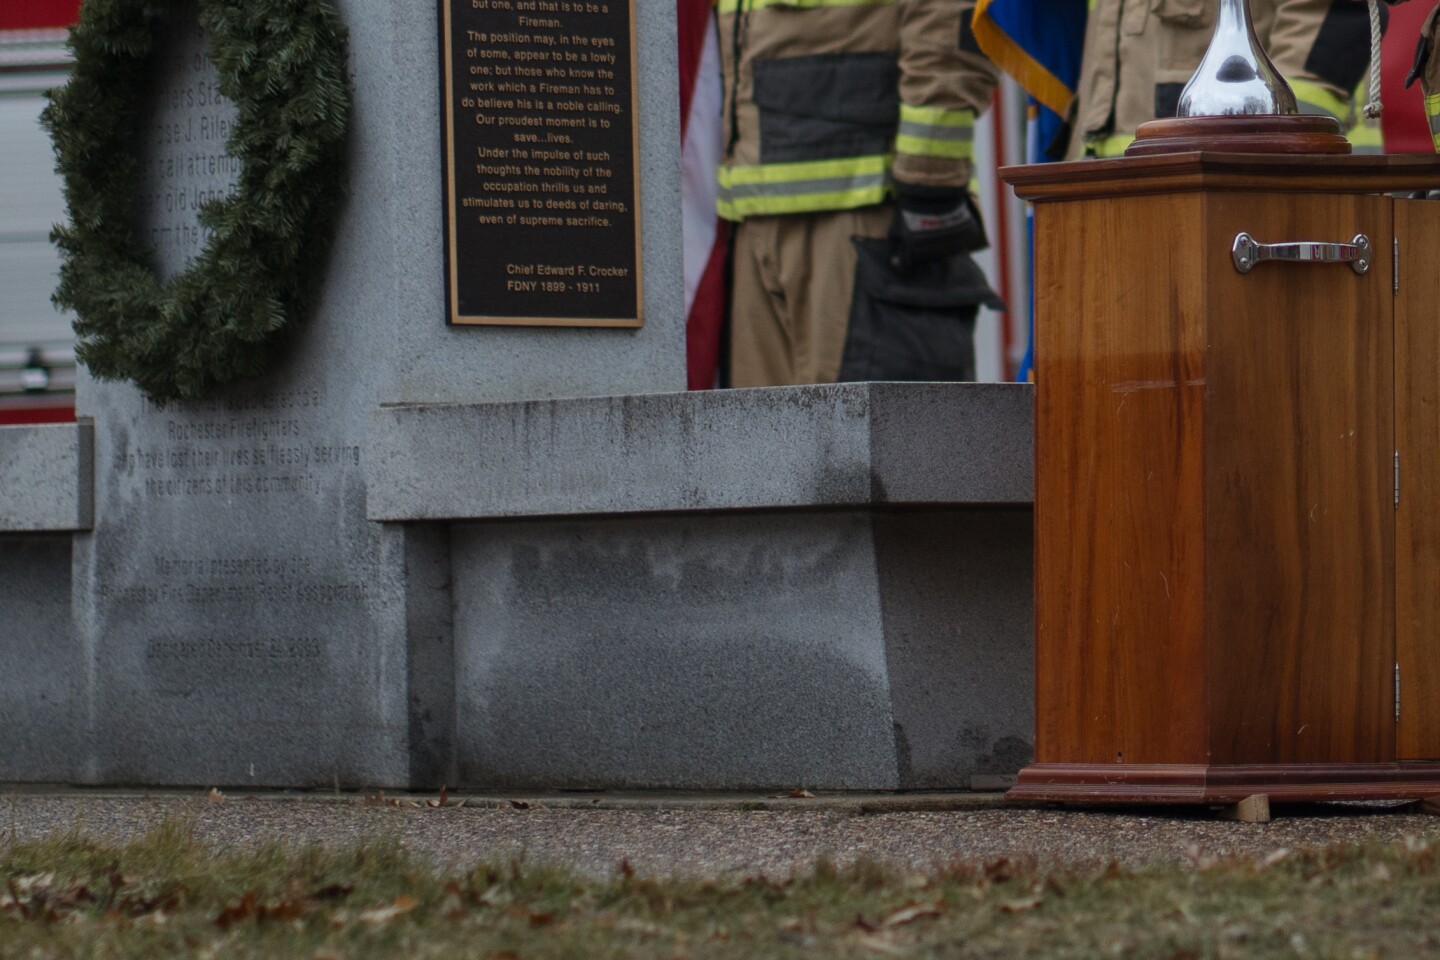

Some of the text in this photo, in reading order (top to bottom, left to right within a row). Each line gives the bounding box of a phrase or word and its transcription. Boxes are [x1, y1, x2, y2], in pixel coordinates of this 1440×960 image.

[516, 0, 536, 10] and
[538, 1, 559, 11] that
[561, 1, 571, 11] is
[572, 2, 584, 12] to
[586, 2, 599, 12] be
[601, 5, 609, 13] a
[467, 30, 488, 41] The
[489, 32, 531, 44] position
[559, 34, 570, 44] in
[571, 34, 589, 45] the
[591, 37, 615, 48] eyes
[466, 47, 478, 57] of
[513, 51, 550, 61] appear
[551, 50, 563, 60] to
[565, 50, 579, 61] be
[580, 53, 588, 61] a
[590, 51, 616, 64] lowly
[495, 65, 512, 75] but
[514, 65, 543, 76] those
[545, 66, 567, 77] who
[568, 67, 595, 78] know
[597, 68, 614, 79] the
[469, 81, 615, 95] work which a Fireman has to
[461, 97, 476, 107] do
[477, 97, 514, 108] believe
[535, 99, 545, 109] is
[556, 100, 585, 111] noble
[475, 114, 611, 128] Our proudest moment is to
[477, 147, 611, 161] Under the impulse of such
[476, 164, 613, 178] thoughts the nobility of the
[482, 181, 607, 193] occupation thrills us and
[462, 197, 515, 207] stimulates
[517, 200, 530, 208] us
[532, 199, 544, 208] to
[545, 199, 577, 209] deeds
[579, 199, 590, 209] of
[478, 216, 504, 224] even
[506, 214, 517, 224] of
[519, 216, 564, 226] supreme
[506, 264, 534, 275] Chief
[536, 264, 575, 275] Edward
[588, 265, 629, 276] Crocker
[507, 280, 538, 291] FDNY
[540, 281, 566, 292] 1899
[576, 281, 600, 292] 1911
